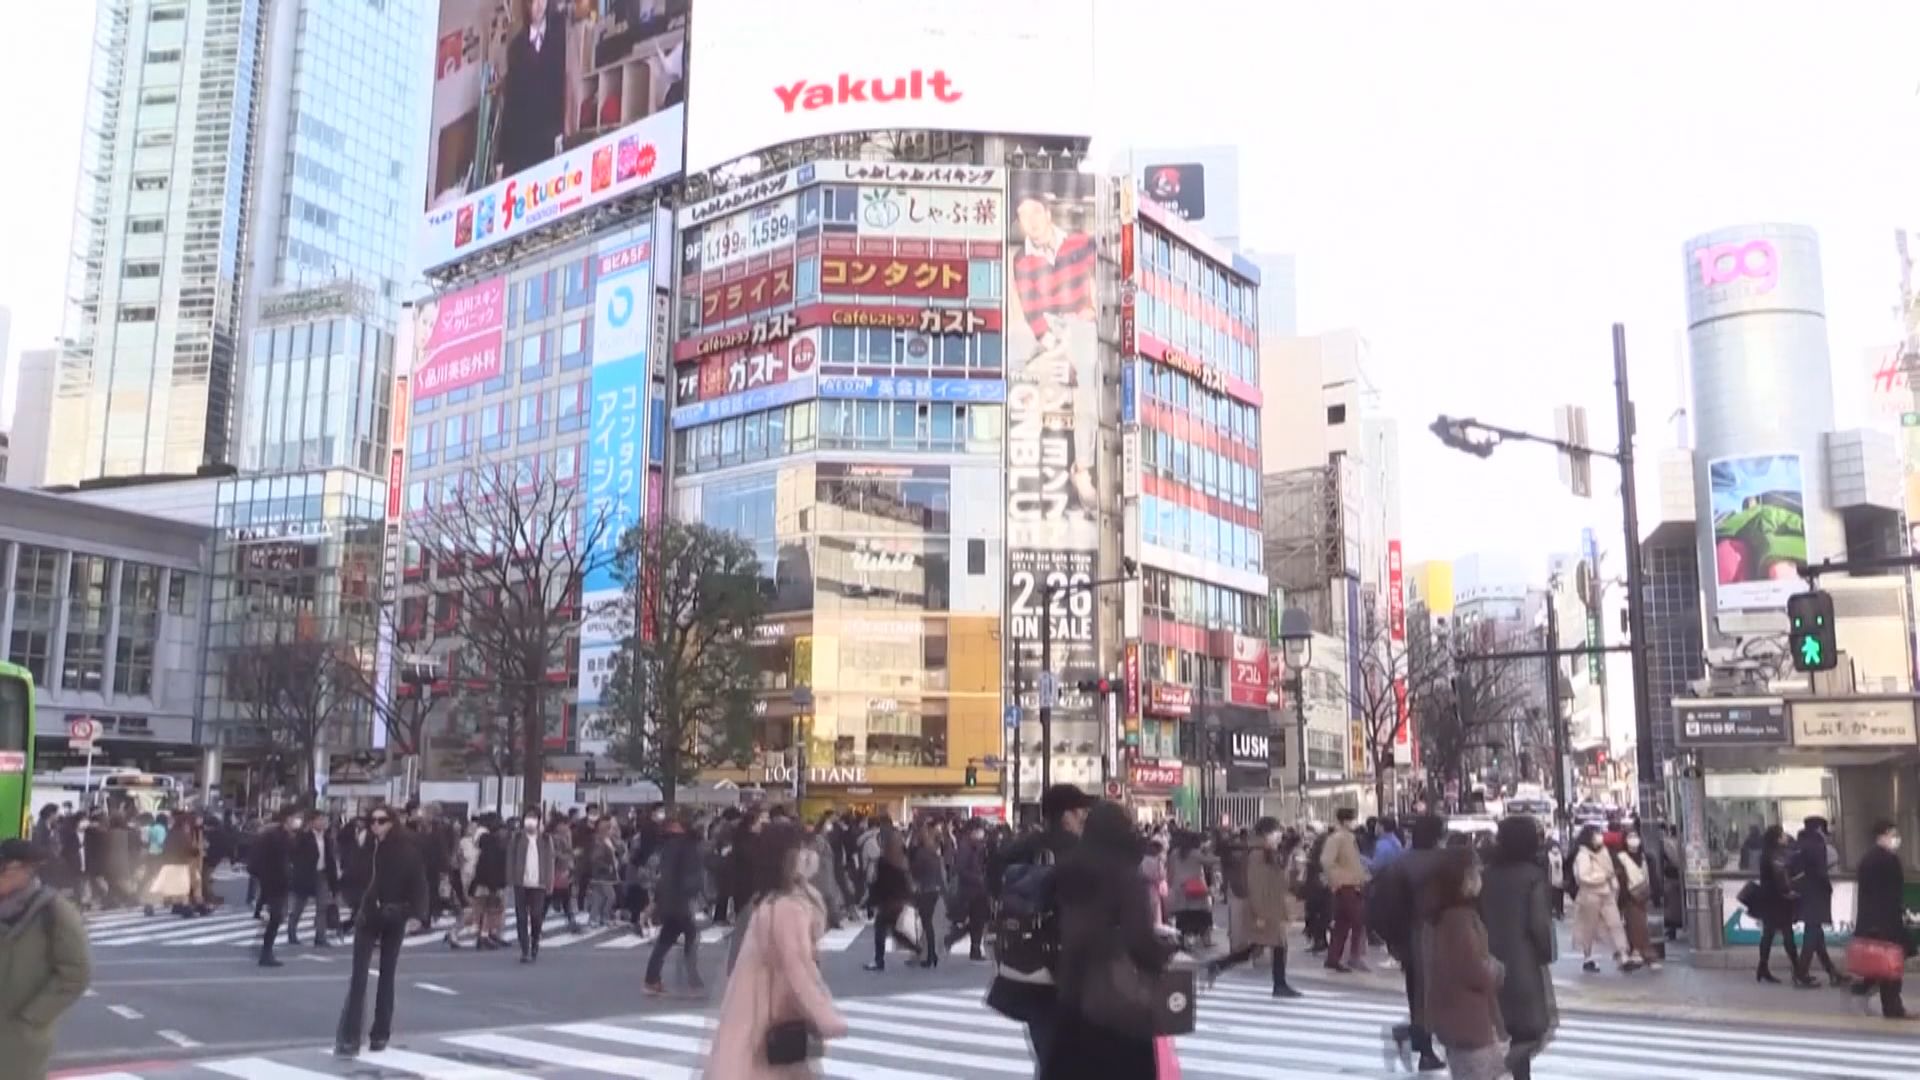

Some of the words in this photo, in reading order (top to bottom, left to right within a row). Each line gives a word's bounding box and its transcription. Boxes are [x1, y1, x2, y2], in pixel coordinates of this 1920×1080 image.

[774, 69, 963, 112] Yakult
[908, 197, 998, 227] しゃぶ葉
[685, 243, 702, 262] 9F
[822, 259, 963, 290] コンタクト
[1695, 239, 1778, 295] 109
[751, 311, 797, 345] ガスト
[919, 308, 986, 333] ガスト
[424, 348, 496, 389] 品川美容外科
[729, 352, 783, 392] ガスト
[679, 374, 698, 398] 7F
[224, 525, 279, 541] MARK
[1012, 571, 1092, 617] 2.26
[1012, 616, 1038, 639] ON
[1049, 617, 1092, 640] SALE
[1237, 663, 1261, 685] アコム
[1232, 733, 1269, 758] LUSH
[764, 765, 866, 784] L'OCITANE
